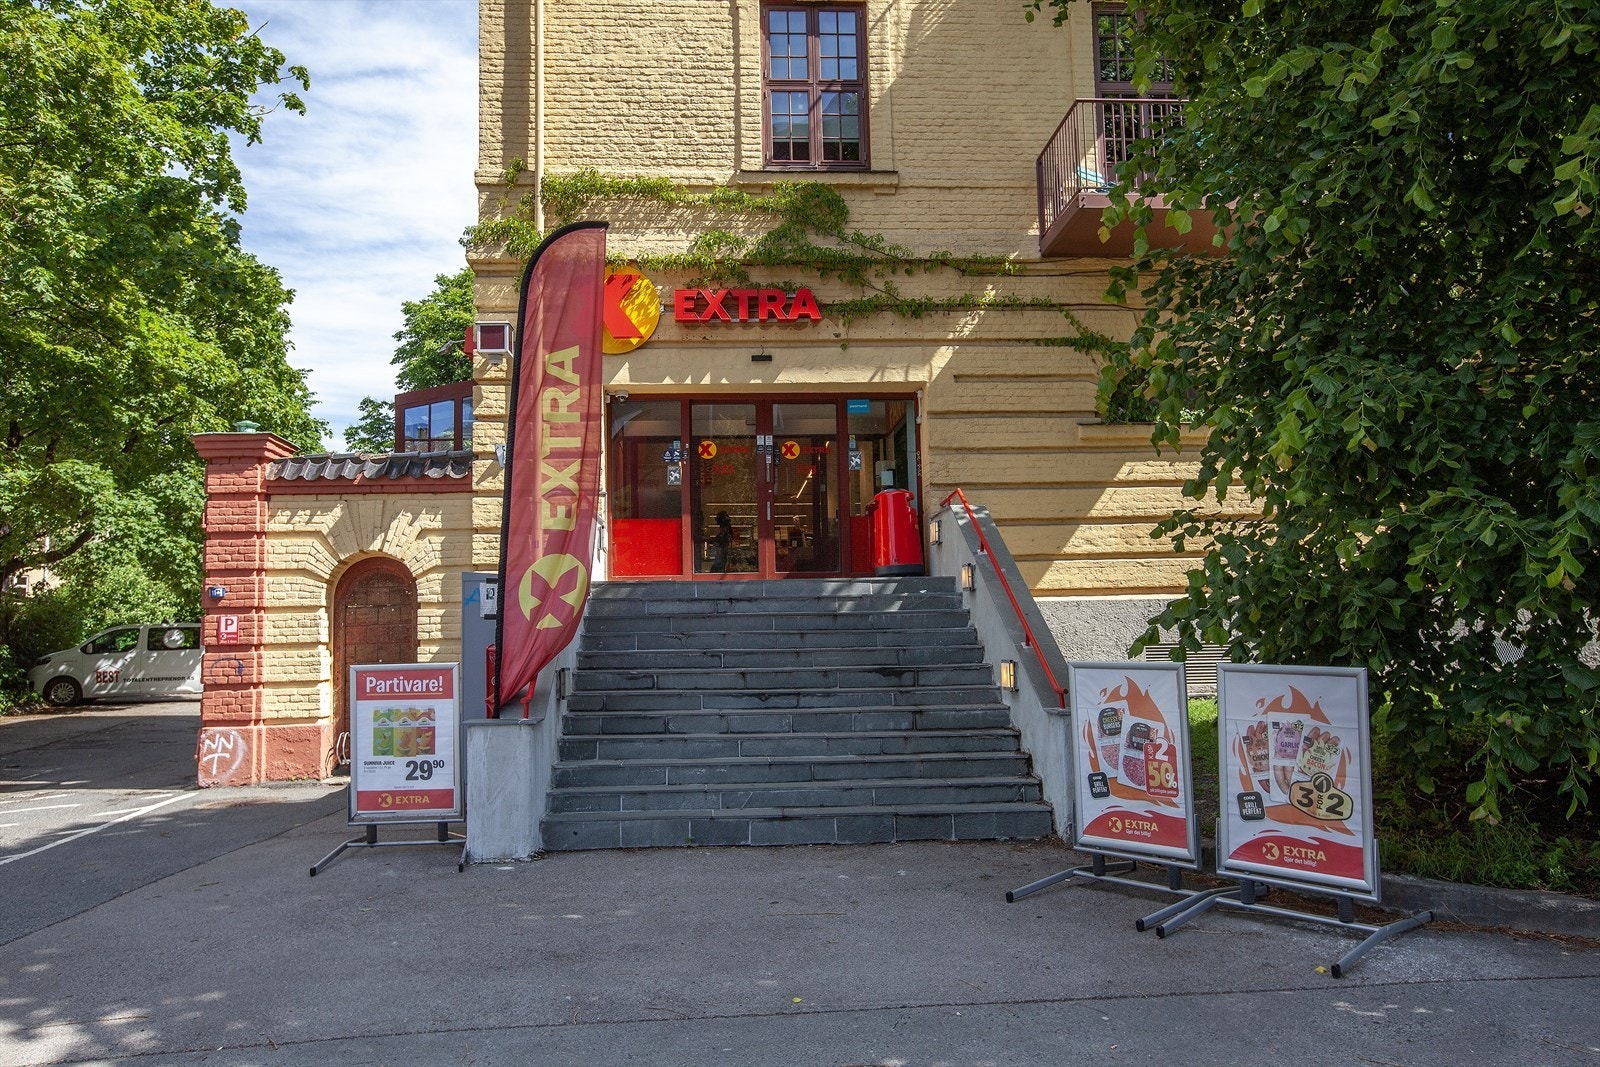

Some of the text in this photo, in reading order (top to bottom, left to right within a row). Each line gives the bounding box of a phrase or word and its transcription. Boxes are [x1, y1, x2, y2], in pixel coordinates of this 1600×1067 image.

[674, 288, 822, 323] EXTRA
[540, 344, 582, 530] EXTRA
[225, 618, 234, 631] P
[95, 670, 121, 683] BEST
[366, 676, 443, 692] Partivare!
[1155, 737, 1169, 761] 2
[405, 760, 445, 781] 29 90
[1306, 759, 1326, 770] BACON
[1148, 761, 1178, 789] 50%
[395, 795, 430, 804] EXTRA
[1297, 786, 1314, 808] 3
[1325, 793, 1345, 816] 2
[1125, 820, 1159, 832] EXTRA
[1283, 845, 1327, 861] EXTRA
